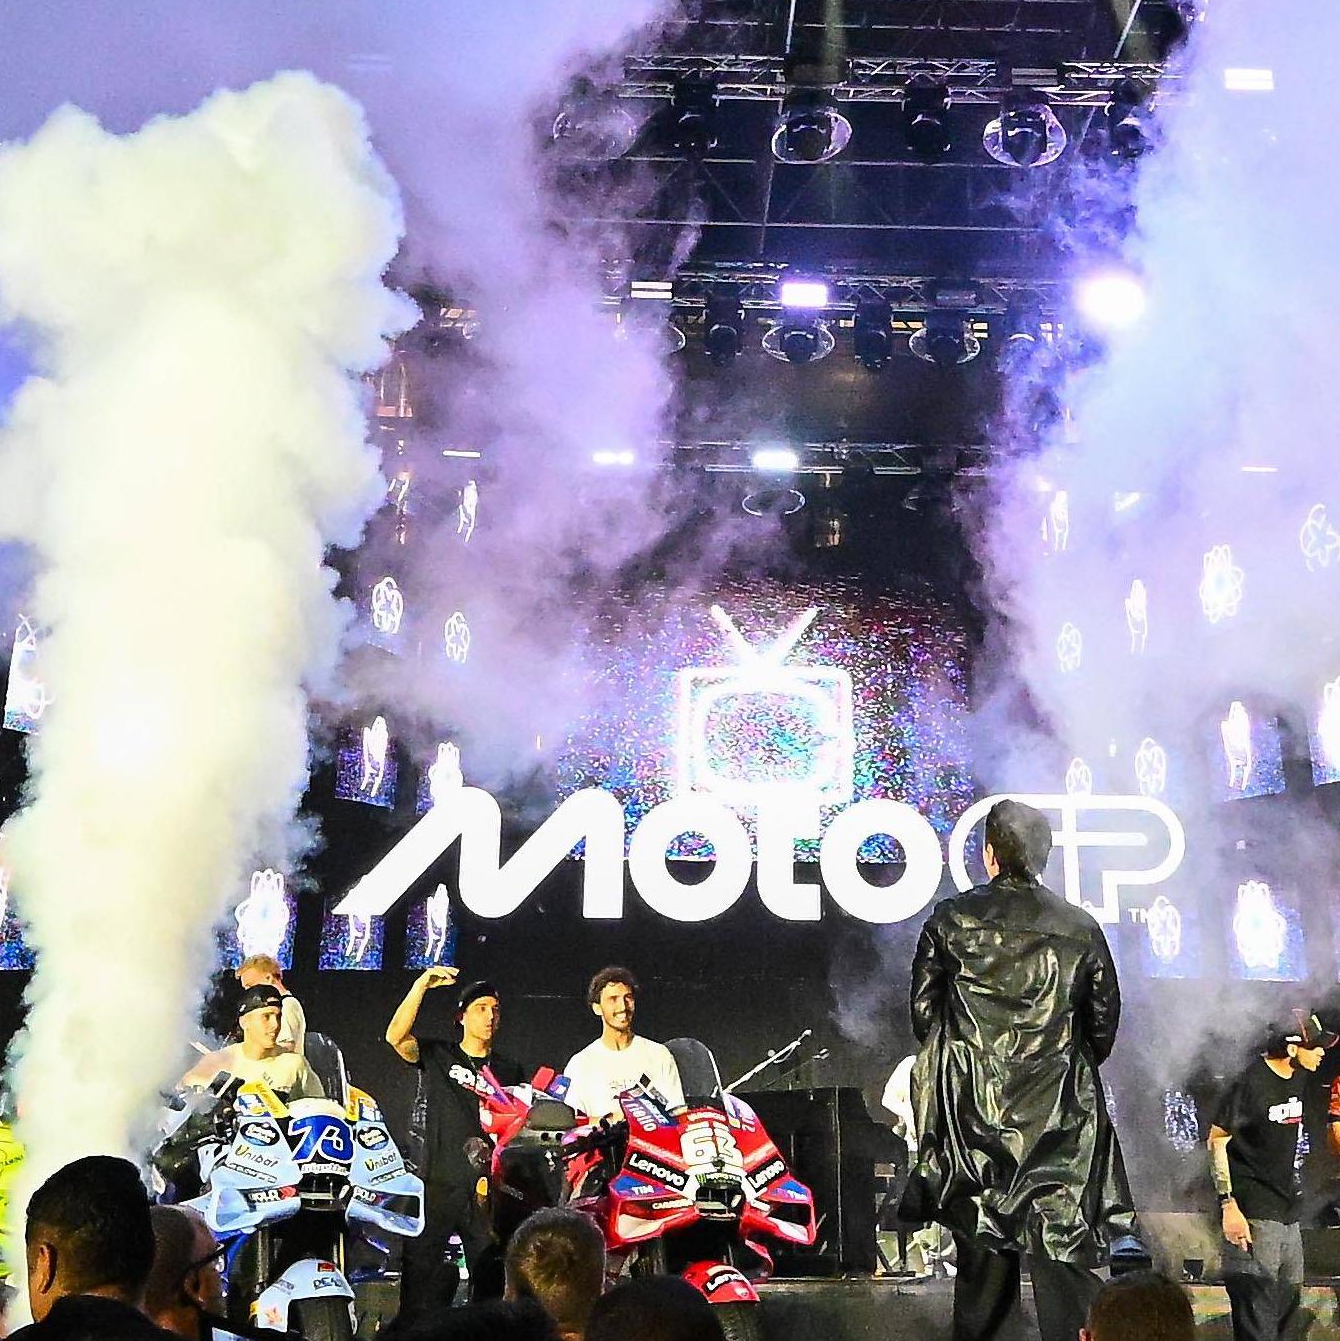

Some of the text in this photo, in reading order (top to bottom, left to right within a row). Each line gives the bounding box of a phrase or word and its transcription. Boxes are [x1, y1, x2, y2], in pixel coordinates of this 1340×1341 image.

[288, 1114, 356, 1164] 73
[680, 1121, 745, 1168] 63
[628, 1153, 685, 1188] Lenovo
